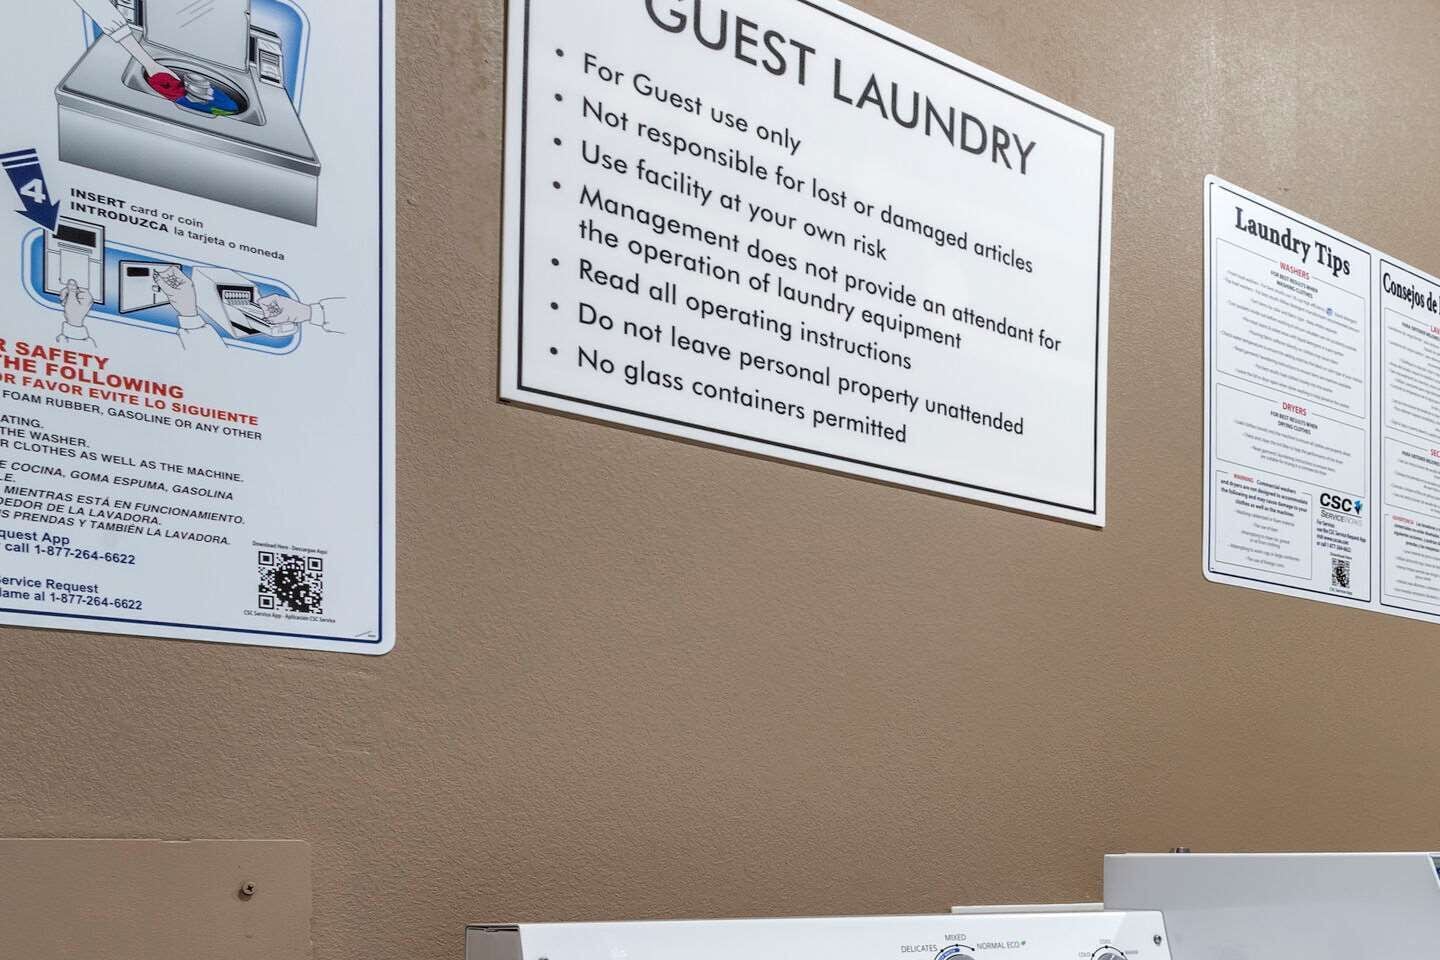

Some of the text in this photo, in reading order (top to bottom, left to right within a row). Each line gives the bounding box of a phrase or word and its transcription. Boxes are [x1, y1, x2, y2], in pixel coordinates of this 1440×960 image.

[584, 54, 802, 156] For Guest use only
[645, 0, 1036, 176] GUEST LAUNDRY
[20, 178, 46, 203] 4
[581, 140, 887, 260] Use facility at your own risk
[582, 95, 1034, 274] Not responsible for lost or damaged articles
[70, 187, 204, 229] INSERT card or coin
[70, 201, 285, 261] INTRODUZCA la tarjeta o moneda
[1234, 206, 1351, 278] Laundry Tips
[579, 185, 1062, 352] Management does not provide an attendant for
[579, 220, 962, 350] the operation of laundry equipment
[1280, 261, 1310, 280] WASHERS
[1382, 272, 1425, 309] Consejos
[1426, 291, 1437, 314] de
[579, 259, 912, 371] Read all operating instructions
[15, 341, 110, 370] SAFETY
[578, 303, 1025, 437] Do not leave personal property unattended
[46, 362, 184, 399] FOLLOWING
[578, 347, 906, 444] No glass containers permitted
[2, 389, 263, 440] FOAM RUBBER, GASOLINE OR ANY OTHER
[22, 376, 83, 396] FAVOR
[89, 388, 140, 406] EVITE
[144, 397, 166, 410] LO
[171, 402, 259, 426] SIGUIENTE
[1282, 402, 1307, 416] DRYERS
[29, 431, 90, 448] WASHER.
[13, 440, 76, 458] CLOTHES
[80, 451, 97, 460] AS
[101, 453, 136, 467] WELL
[139, 459, 157, 470] AS
[160, 462, 184, 473] THE
[187, 466, 244, 482] MACHINE.
[11, 462, 66, 478] COCINA,
[70, 470, 110, 483] GOMA
[113, 476, 168, 492] ESPUMA,
[172, 484, 234, 500] GASOLINA
[4, 485, 73, 502] MIENTRAS
[114, 500, 132, 509] EN
[134, 502, 245, 524] FUNCIONAMIENTO.
[46, 503, 162, 525] DE LA LAVADORA.
[1319, 492, 1352, 512] CSC
[13, 511, 75, 526] PRENDAS
[79, 519, 87, 527] Y
[146, 527, 162, 537] LA
[165, 529, 231, 544] LAVADORA.
[41, 532, 70, 546] App
[5, 543, 136, 565] call 1-877-264-6622
[34, 592, 142, 610] al 1-877-264-6622
[46, 578, 99, 594] Request
[900, 944, 938, 953] DELICATES
[977, 942, 1006, 950] NORMAL
